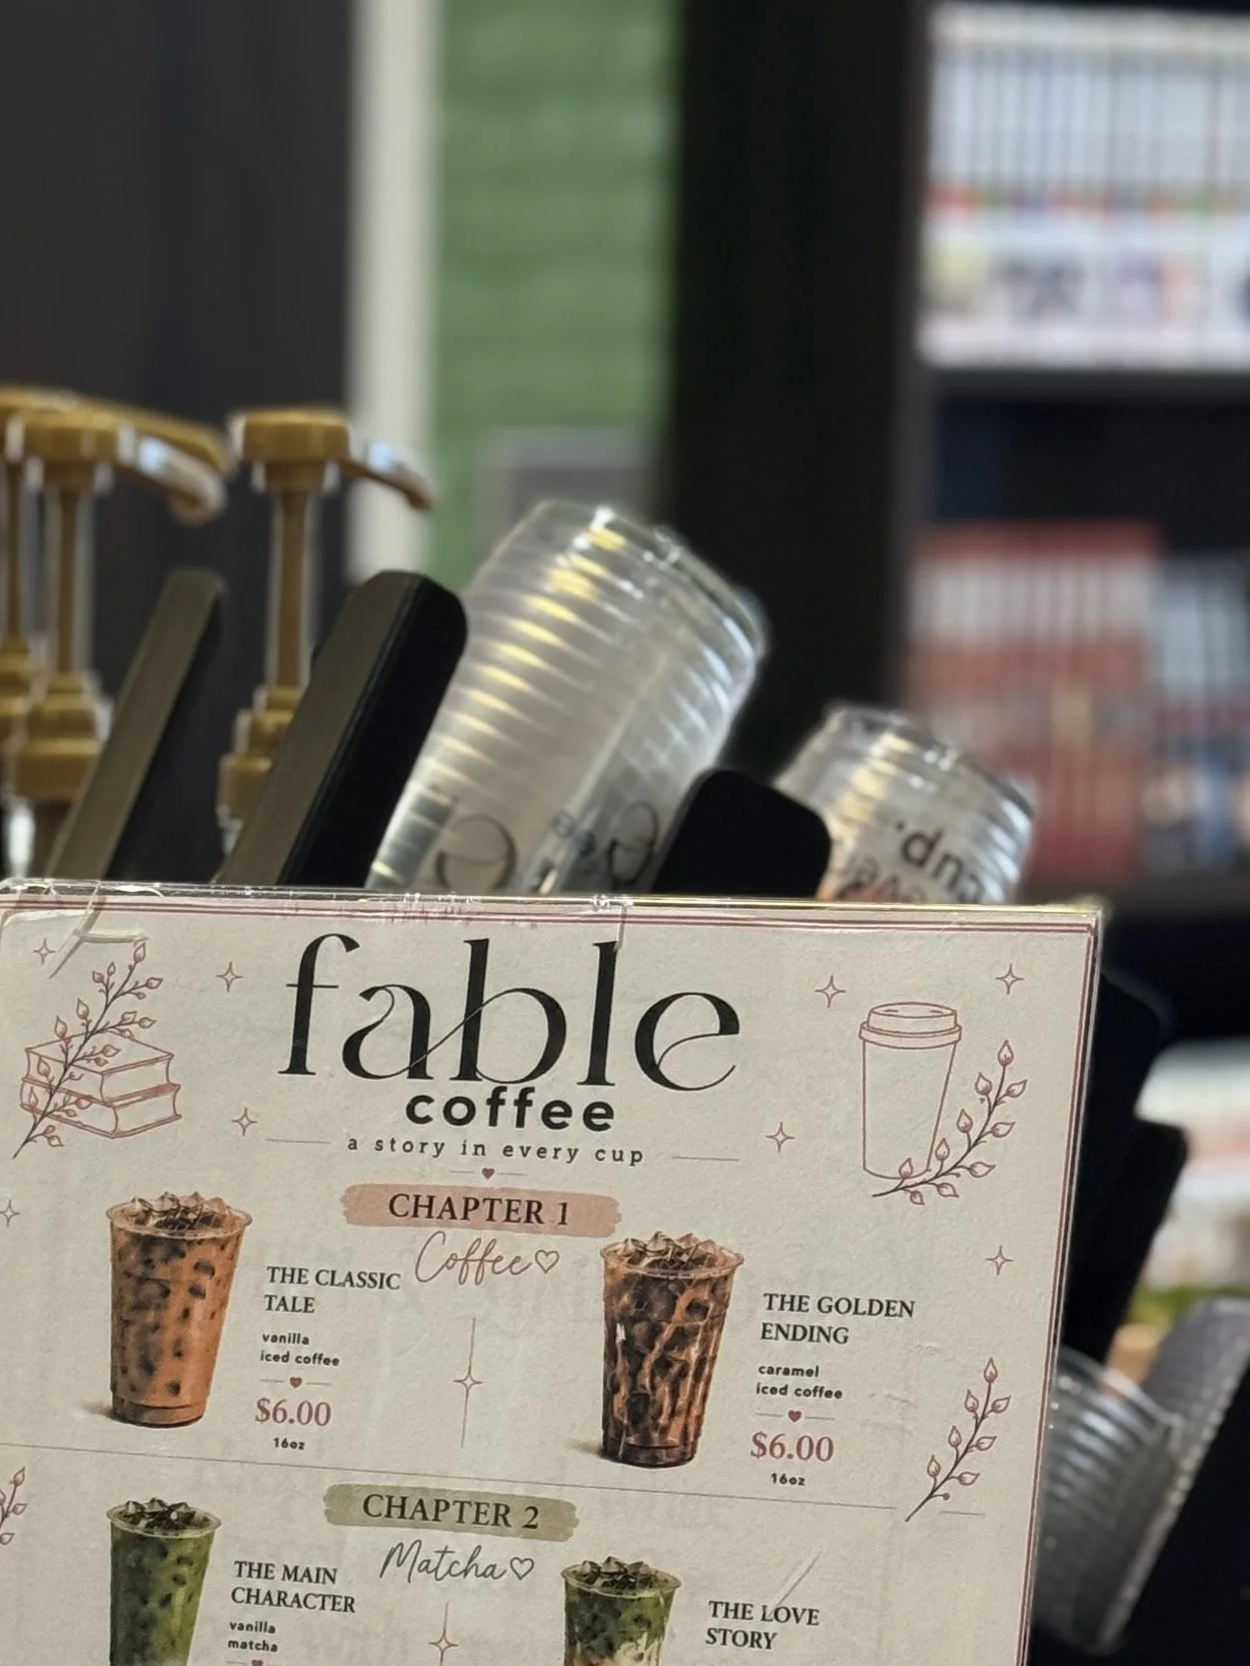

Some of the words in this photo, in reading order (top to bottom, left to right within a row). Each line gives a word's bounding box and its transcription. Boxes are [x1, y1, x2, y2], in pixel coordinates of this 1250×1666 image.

[278, 933, 741, 1091] fable
[406, 1086, 614, 1132] coffee
[348, 1137, 359, 1151] a
[374, 1136, 446, 1159] story
[460, 1139, 486, 1157] in
[503, 1144, 579, 1164] every
[595, 1149, 644, 1167] cup
[388, 1193, 545, 1225] CHAPTER
[557, 1202, 569, 1226] 1
[415, 1231, 533, 1286] Coffee
[266, 1266, 309, 1286] THE
[314, 1269, 401, 1290] CLASSIC
[264, 1294, 316, 1314] TALE
[763, 1293, 810, 1313] THE
[817, 1296, 916, 1318] GOLDEN
[262, 1332, 310, 1346] vanilla
[760, 1322, 849, 1344] ENDING
[260, 1351, 290, 1364] iced
[295, 1352, 340, 1367] coffee
[758, 1366, 819, 1377] caramel
[756, 1382, 788, 1396] iced
[794, 1385, 843, 1399] coffee
[255, 1398, 332, 1426] $6.00
[272, 1437, 306, 1451] 16oz
[750, 1431, 834, 1462] $6.00
[771, 1473, 805, 1486] 16oz
[362, 1493, 512, 1528] CHAPTER
[522, 1505, 540, 1529] 2
[234, 1560, 275, 1579] THE
[281, 1564, 338, 1585] MAIN
[379, 1539, 506, 1584] Matcha
[231, 1586, 356, 1614] CHARACTER
[708, 1600, 754, 1621] THE
[761, 1604, 820, 1626] LOVE
[229, 1620, 276, 1634] vanilla
[705, 1627, 778, 1650] STORY
[228, 1638, 278, 1652] matcha
